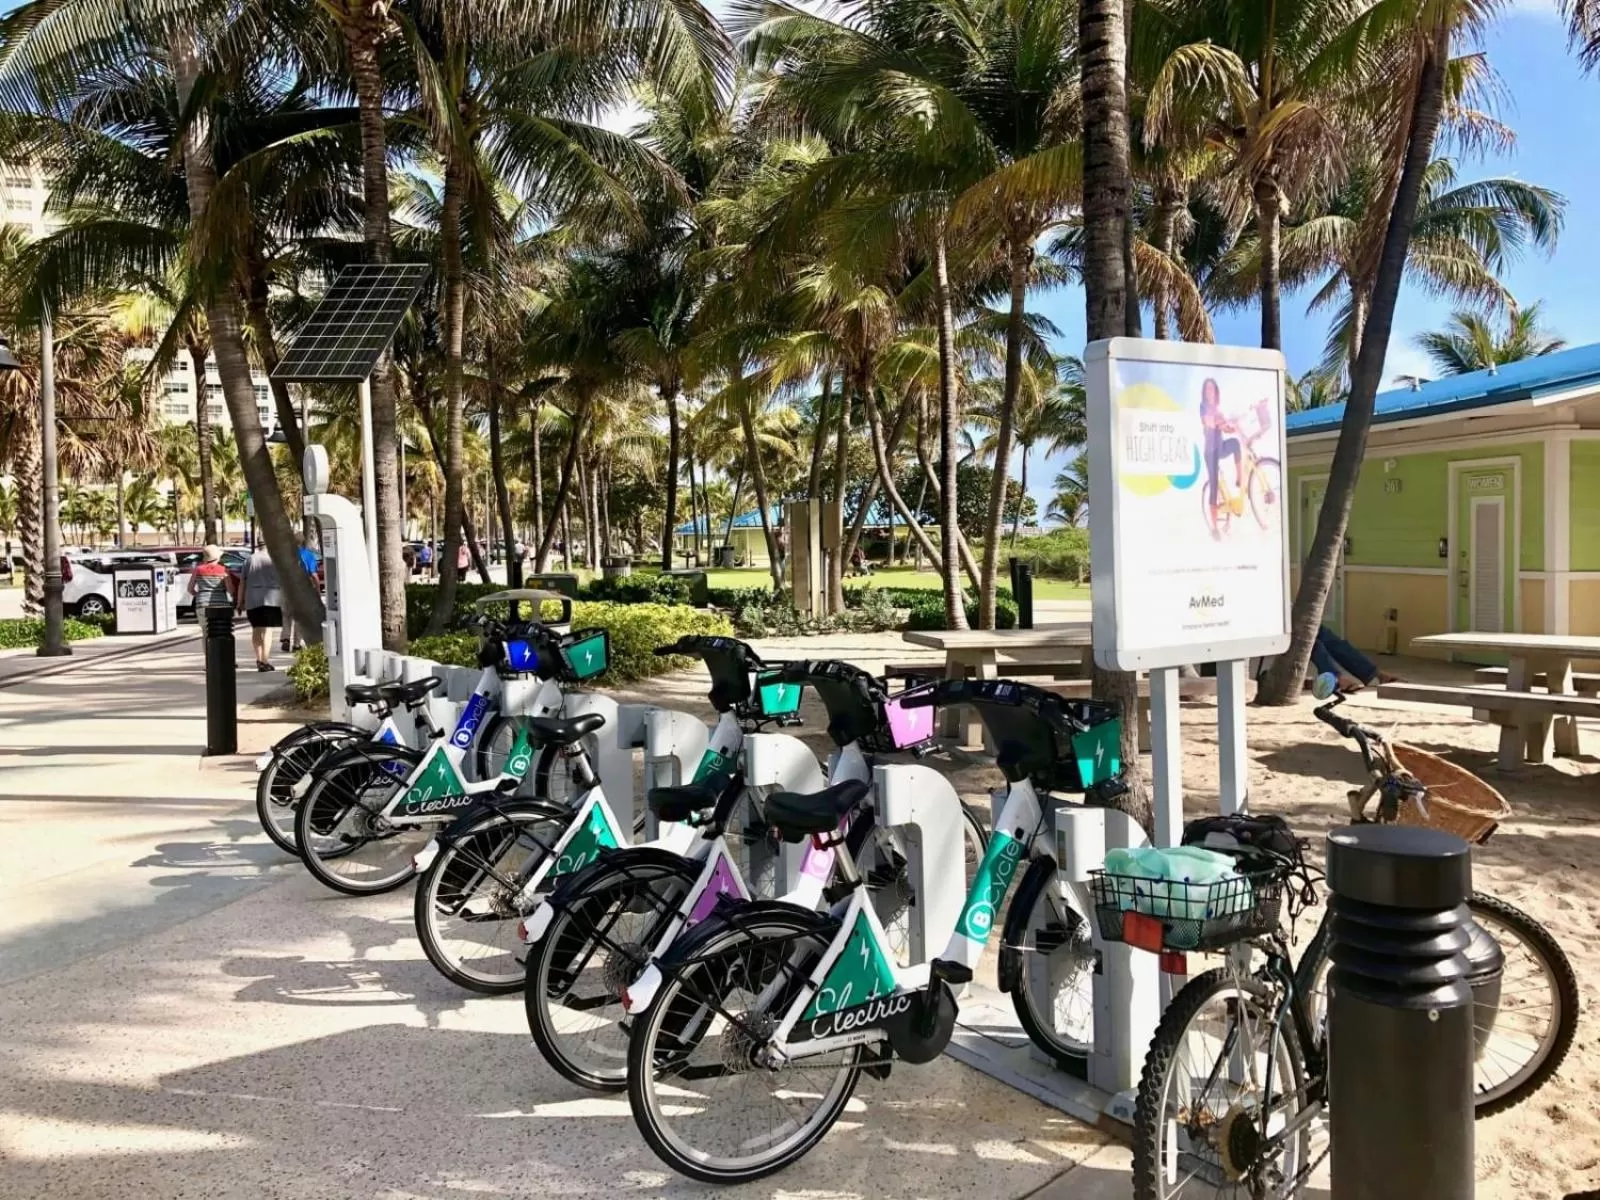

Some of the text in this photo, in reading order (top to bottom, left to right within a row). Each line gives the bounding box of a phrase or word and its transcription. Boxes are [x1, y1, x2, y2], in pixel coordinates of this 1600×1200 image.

[1139, 421, 1176, 434] Shift into
[1125, 435, 1190, 463] HIGH GEAR
[1468, 476, 1503, 489] WOMEN
[1188, 594, 1225, 609] AvMed
[405, 786, 474, 815] Electric
[965, 841, 1020, 939] BCycle
[811, 978, 912, 1040] Electric
